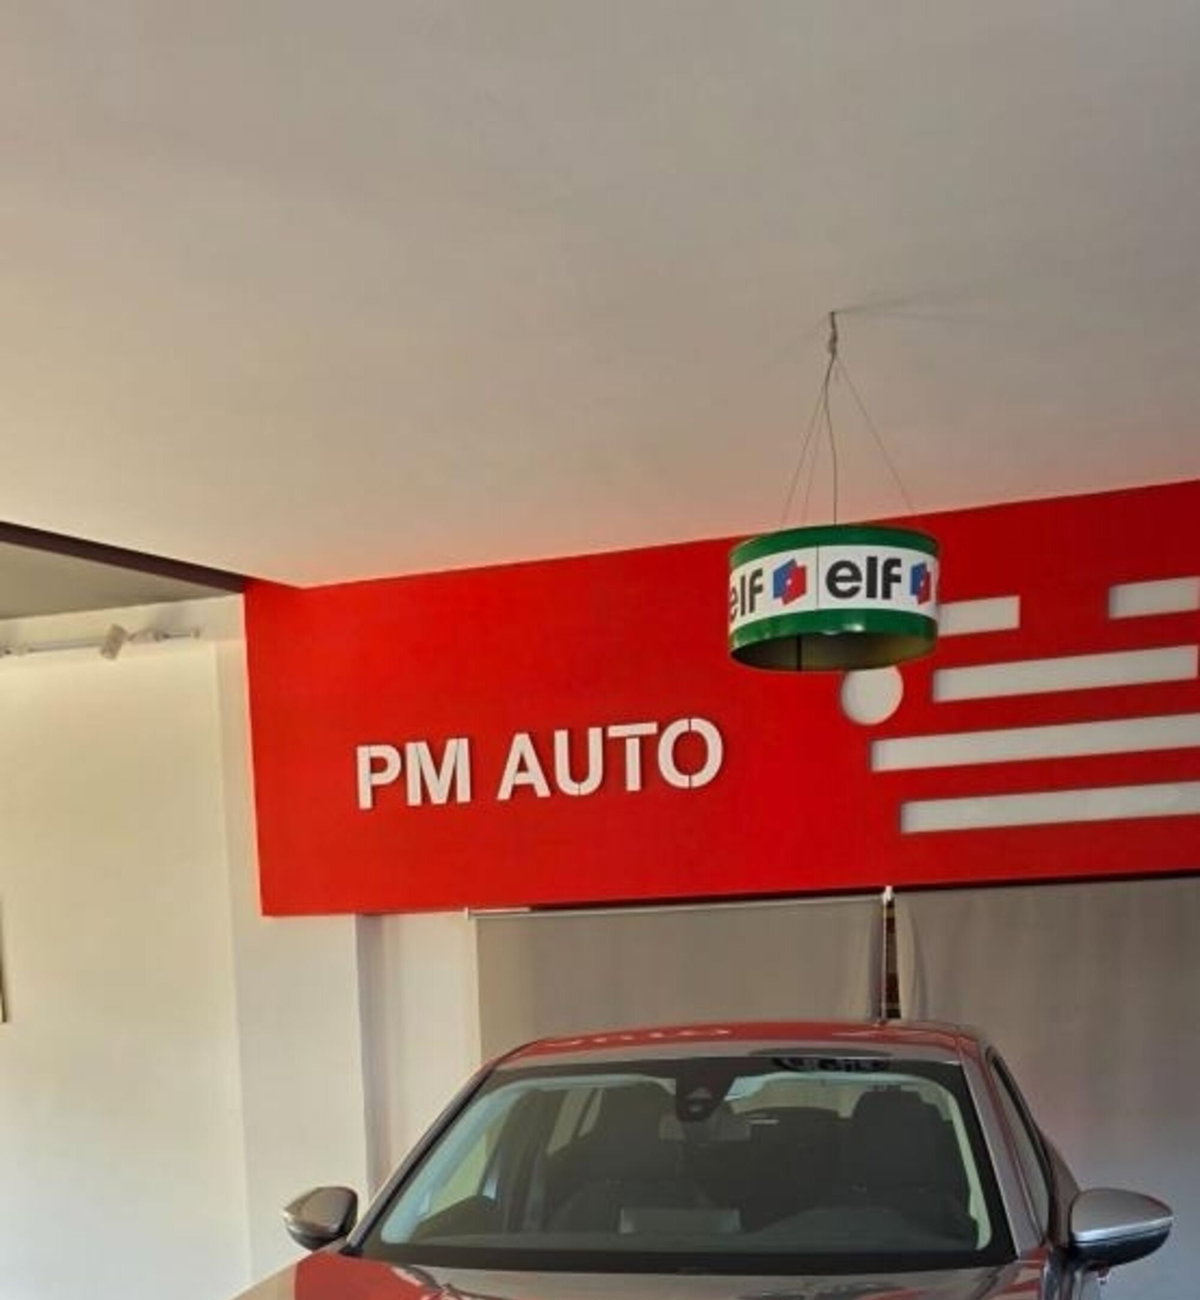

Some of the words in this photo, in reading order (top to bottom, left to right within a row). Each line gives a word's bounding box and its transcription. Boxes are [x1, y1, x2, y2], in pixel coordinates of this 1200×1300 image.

[825, 556, 902, 600] elf
[357, 737, 471, 810] PM
[497, 717, 724, 801] AUTO
